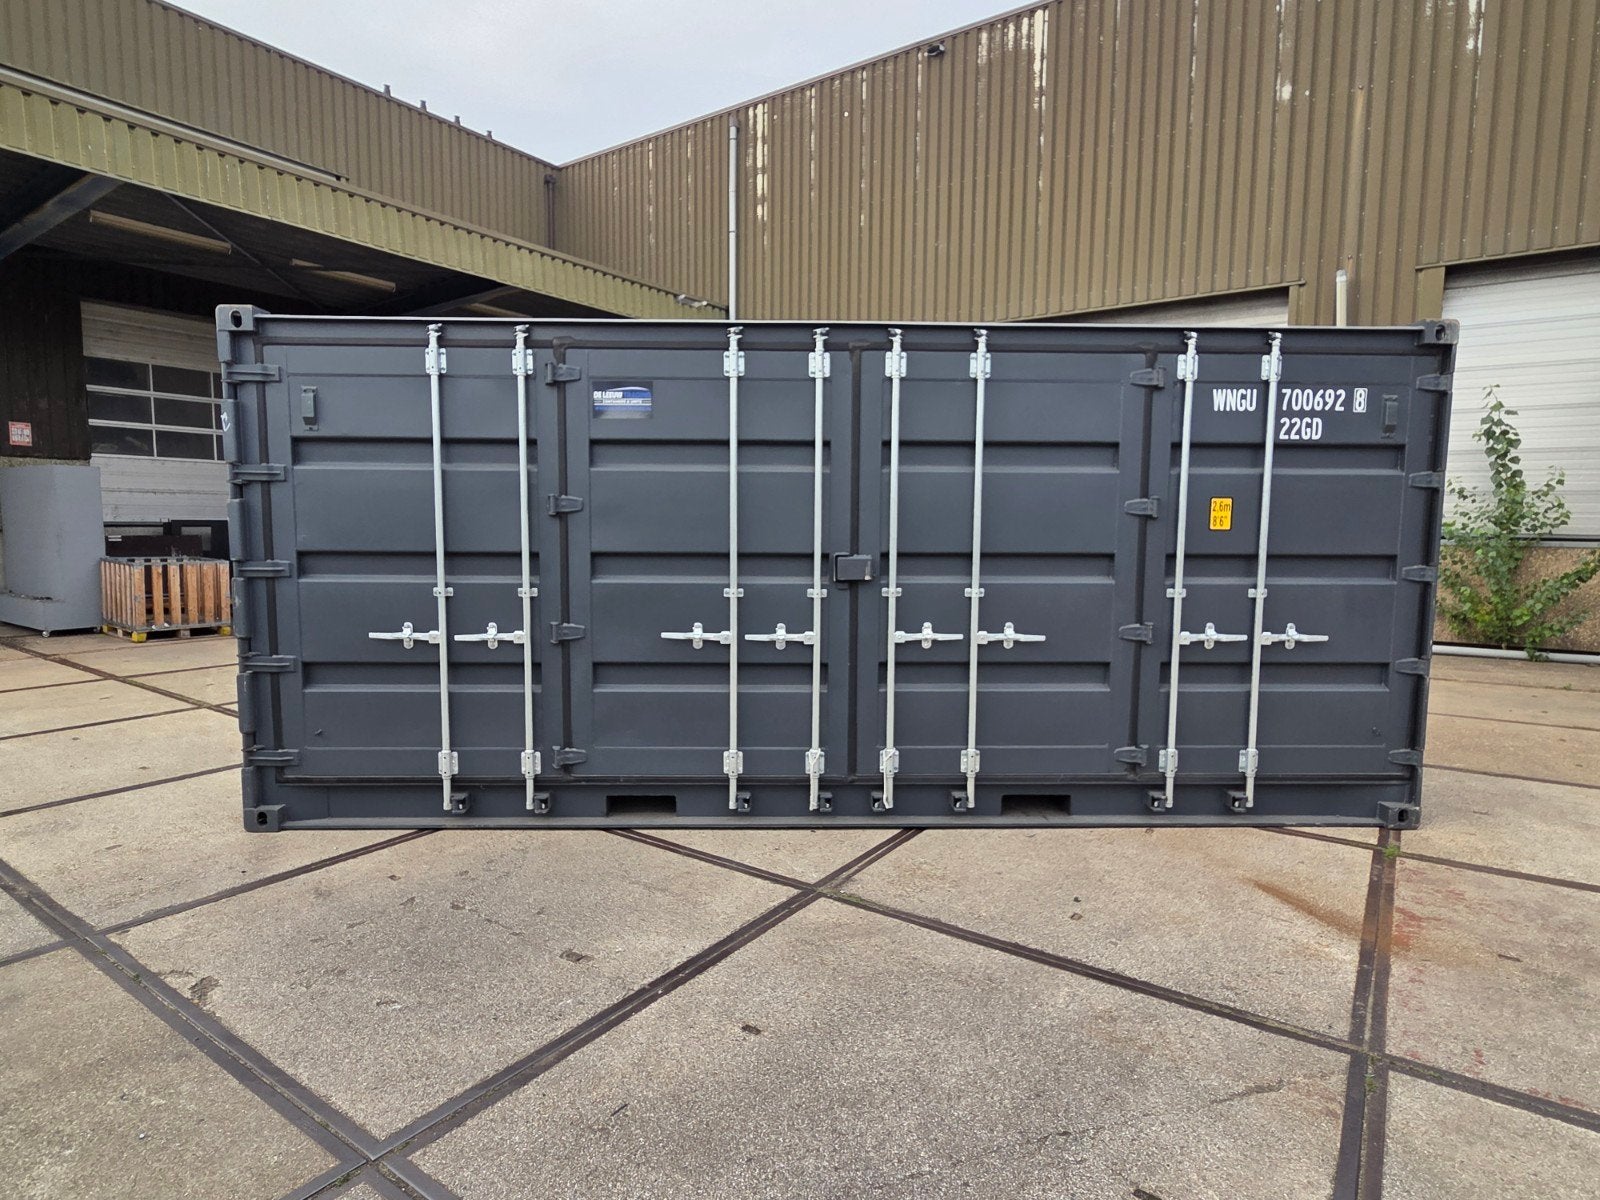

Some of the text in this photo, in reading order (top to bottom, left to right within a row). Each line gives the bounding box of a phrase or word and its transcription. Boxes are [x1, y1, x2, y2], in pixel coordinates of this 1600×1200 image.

[1212, 388, 1367, 412] WNGU 700692 8
[1279, 417, 1323, 440] 22GD
